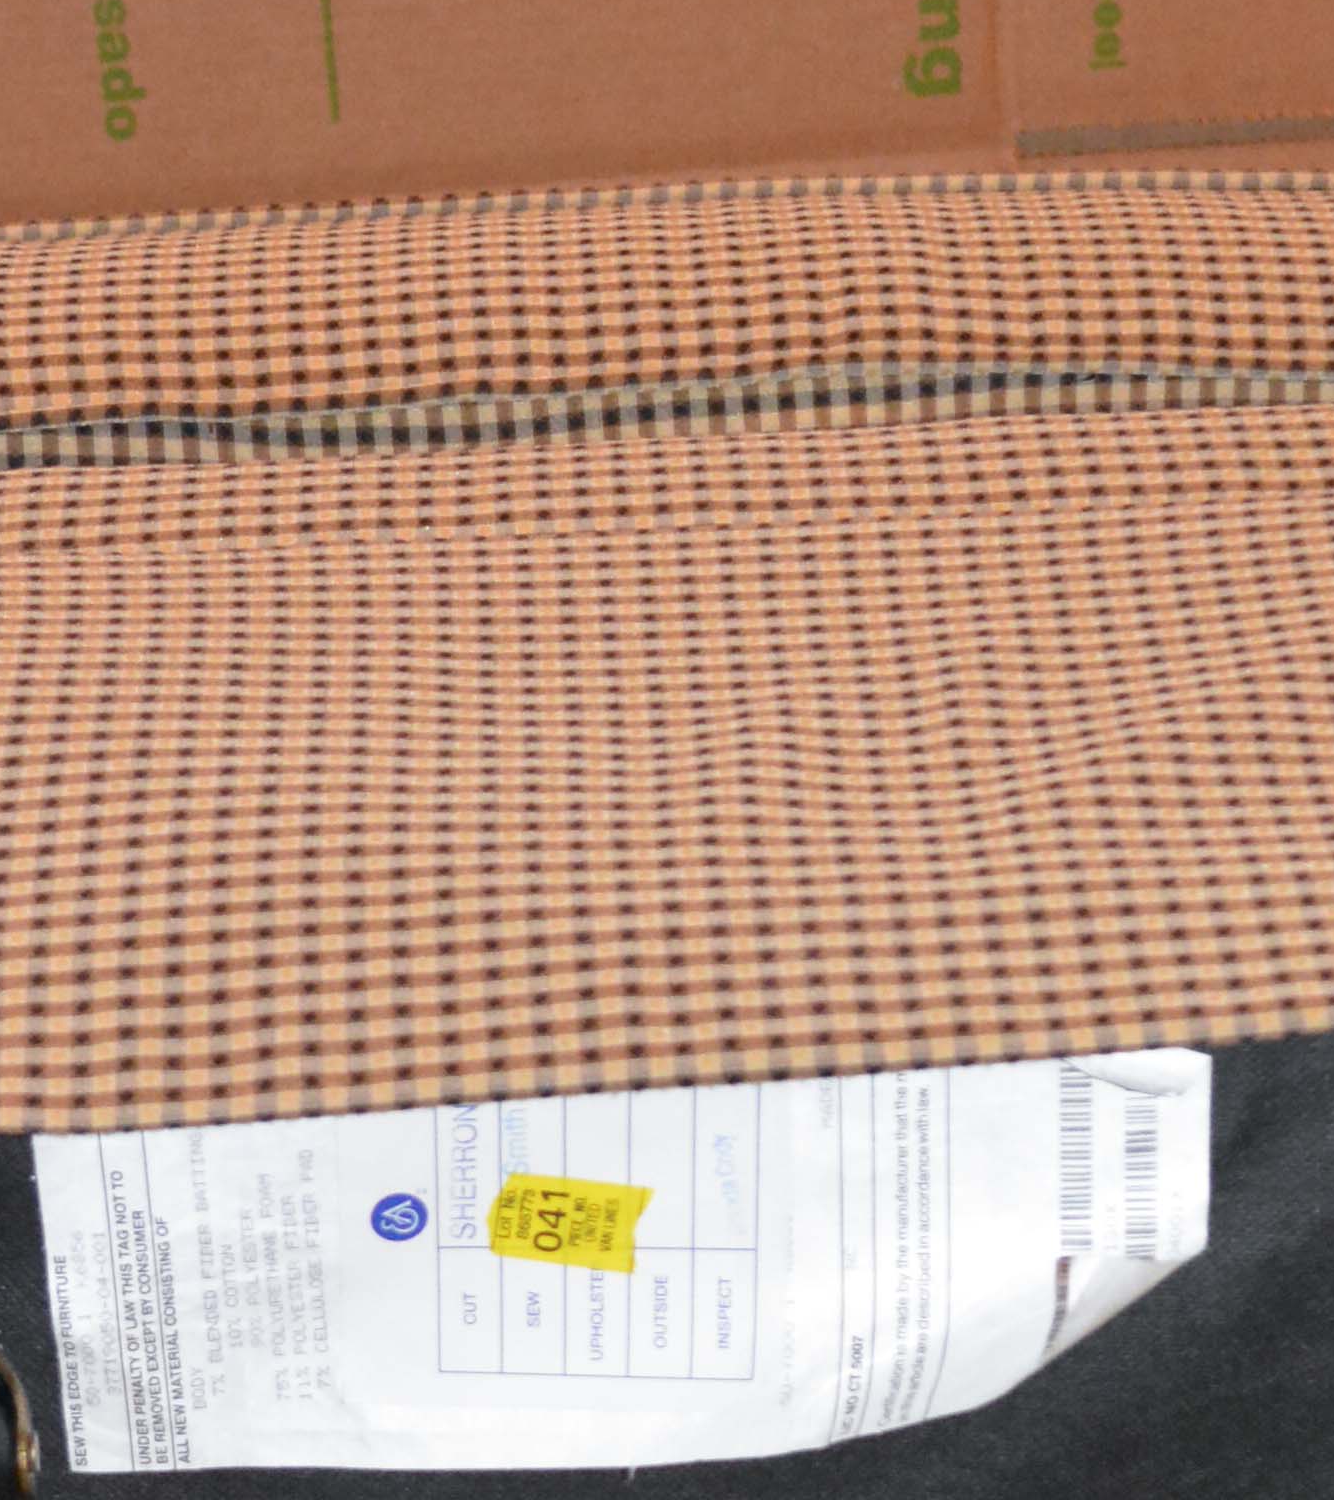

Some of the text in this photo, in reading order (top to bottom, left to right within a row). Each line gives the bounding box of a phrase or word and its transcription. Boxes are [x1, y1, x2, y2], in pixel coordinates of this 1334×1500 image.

[893, 1086, 908, 1109] the
[894, 1113, 908, 1141] that
[533, 1189, 570, 1252] 041
[893, 1146, 910, 1241] manufacturer
[498, 1216, 512, 1239] Lot
[894, 1245, 910, 1269] the
[463, 1292, 477, 1325] CUT
[527, 1291, 541, 1327] SEW
[590, 1266, 605, 1361] UPHOLSTE
[653, 1275, 669, 1349] OUTSIDE
[717, 1276, 732, 1349] INSPECT
[894, 1273, 914, 1292] by
[111, 1170, 152, 1464] UNDER PENALTY OF LAW THIS TAG NOT TO
[132, 1210, 169, 1464] BE REMOVED EXCEPT BY CONSUMER
[155, 1217, 191, 1464] ALL NEW MATERIAL CONSISTING OF
[894, 1299, 909, 1340] made
[54, 1255, 88, 1466] SEW THIS EDGE TO FURNITURE
